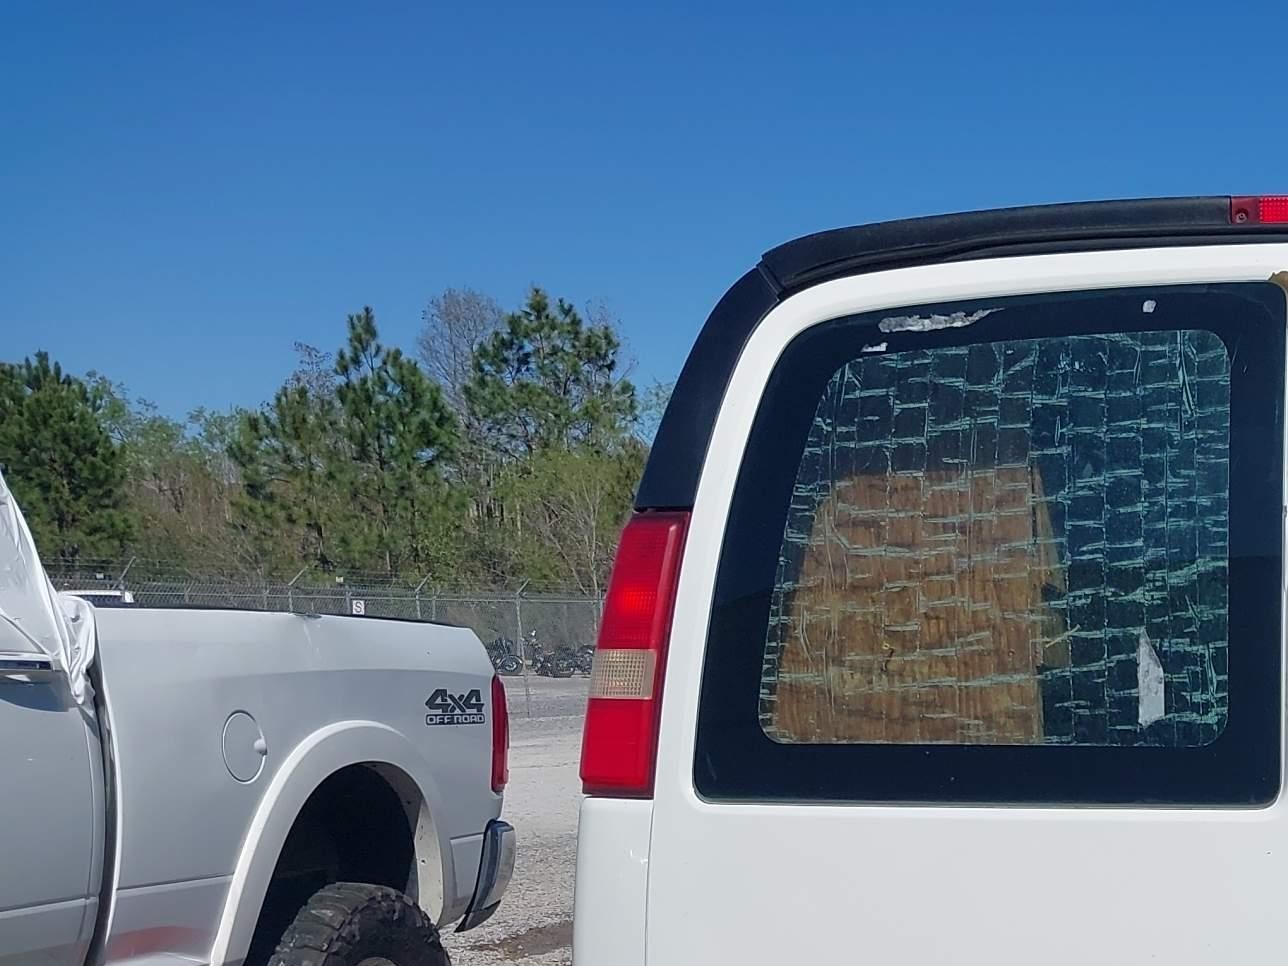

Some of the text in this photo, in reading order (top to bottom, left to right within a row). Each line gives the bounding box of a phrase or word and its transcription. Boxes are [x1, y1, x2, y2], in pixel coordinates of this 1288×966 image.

[425, 689, 484, 713] 4x4
[427, 715, 485, 724] OFF ROAD
